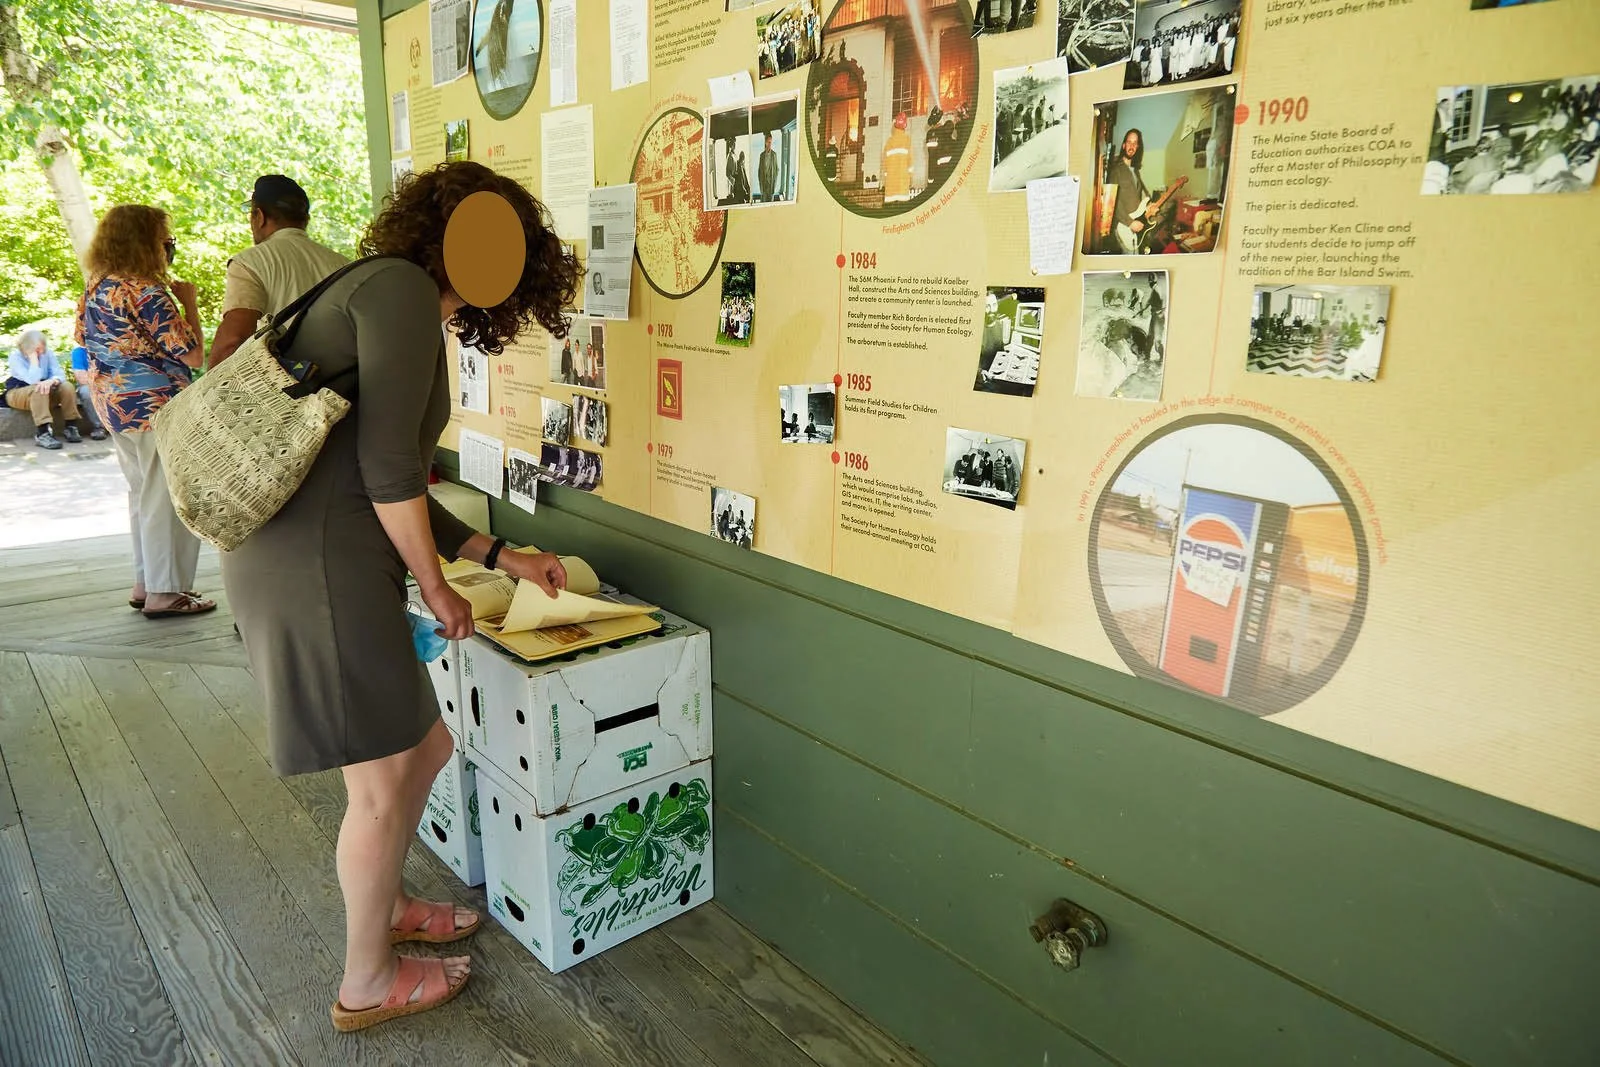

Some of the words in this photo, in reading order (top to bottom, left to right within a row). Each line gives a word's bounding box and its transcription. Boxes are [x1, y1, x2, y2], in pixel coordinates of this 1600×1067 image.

[1265, 16, 1282, 30] just
[1286, 13, 1299, 23] six
[1302, 9, 1333, 23] years
[1336, 3, 1364, 15] after
[1367, 0, 1385, 9] the
[1258, 96, 1309, 126] 1990
[1253, 136, 1270, 145] The
[1273, 133, 1307, 144] Maine
[1310, 130, 1338, 141] State
[1342, 125, 1378, 138] Board
[1381, 122, 1395, 135] of
[1251, 147, 1301, 159] Education
[1305, 143, 1364, 155] authorizes
[1368, 140, 1396, 151] COA
[1400, 139, 1412, 149] to
[1250, 162, 1274, 174] offer
[1287, 159, 1324, 171] Master
[1328, 158, 1340, 169] of
[1342, 154, 1408, 168] Philosophy
[1411, 154, 1422, 163] in
[882, 222, 916, 234] Firefighters
[916, 212, 930, 224] fight
[930, 204, 941, 215] the
[940, 187, 958, 206] blaze
[978, 122, 989, 146] Hall.
[1248, 177, 1283, 188] human
[1287, 175, 1332, 189] ecology.
[1246, 202, 1263, 212] The
[1266, 201, 1286, 213] pier
[1300, 198, 1358, 210] dedicated.
[1243, 225, 1279, 237] Faculty
[1282, 223, 1326, 235] member
[1329, 224, 1351, 233] Ken
[1355, 222, 1383, 233] Cline
[1387, 222, 1412, 233] and
[1242, 238, 1262, 248] four
[1265, 238, 1308, 248] students
[1311, 238, 1348, 248] decide
[1351, 239, 1361, 248] to
[1364, 238, 1395, 250] jump
[1398, 236, 1417, 248] off
[850, 252, 877, 269] 1984
[1240, 252, 1252, 262] of
[1252, 252, 1268, 262] the
[1296, 252, 1319, 264] pier,
[1322, 252, 1378, 264] launching
[1382, 252, 1400, 262] the
[1239, 266, 1281, 276] tradition
[1284, 266, 1297, 276] of
[1298, 267, 1313, 277] the
[1317, 268, 1336, 277] Bar
[1340, 267, 1374, 278] Island
[1378, 267, 1413, 278] Swim.
[943, 278, 968, 286] Kaelber
[952, 288, 979, 297] building,
[883, 297, 914, 306] community
[942, 298, 973, 307] launched.
[848, 311, 867, 320] Faculty
[906, 314, 927, 322] Borden
[935, 315, 957, 324] elected
[958, 317, 971, 325] first
[658, 324, 673, 338] 1978
[848, 322, 872, 331] president
[891, 323, 912, 333] Society
[923, 326, 945, 334] Human
[947, 327, 973, 337] Ecology.
[858, 338, 887, 347] arboretum
[893, 341, 928, 350] established.
[847, 374, 872, 392] 1985
[845, 395, 866, 404] Summer
[868, 398, 880, 407] Field
[882, 400, 901, 410] Studies
[913, 403, 938, 414] Children
[845, 404, 859, 413] holds
[867, 407, 877, 416] first
[878, 410, 907, 420] programs.
[658, 443, 672, 458] 1979
[1079, 490, 1094, 511] 1991,
[1091, 458, 1106, 478] Pepsi
[1105, 428, 1131, 458] machine
[1139, 404, 1168, 425] hauled
[1182, 397, 1195, 408] the
[1198, 394, 1220, 406] edge
[1237, 399, 1273, 414] campus
[844, 452, 869, 471] 1986
[852, 474, 863, 483] Arts
[864, 477, 874, 485] and
[876, 479, 898, 491] Sciences
[900, 484, 924, 497] building,
[842, 482, 857, 491] which
[858, 485, 874, 495] would
[876, 489, 899, 501] comprise
[901, 494, 914, 504] labs,
[916, 498, 938, 509] studios,
[852, 494, 874, 504] services,
[883, 499, 892, 508] the
[893, 502, 912, 514] writing
[914, 507, 932, 518] center,
[852, 503, 867, 512] more,
[874, 507, 896, 518] opened.
[841, 514, 850, 522] The
[851, 516, 869, 528] Society
[878, 523, 897, 535] Human
[899, 528, 920, 541] Ecology
[921, 533, 936, 544] holds
[841, 522, 852, 531] their
[853, 525, 890, 542] second-annual
[891, 536, 913, 549] meeting
[921, 543, 936, 553] COA.
[1179, 539, 1247, 572] PEPSI
[623, 751, 647, 772] PCA
[568, 863, 706, 939] Vegetables
[646, 903, 668, 917] FARM
[614, 916, 643, 931] FRESH
